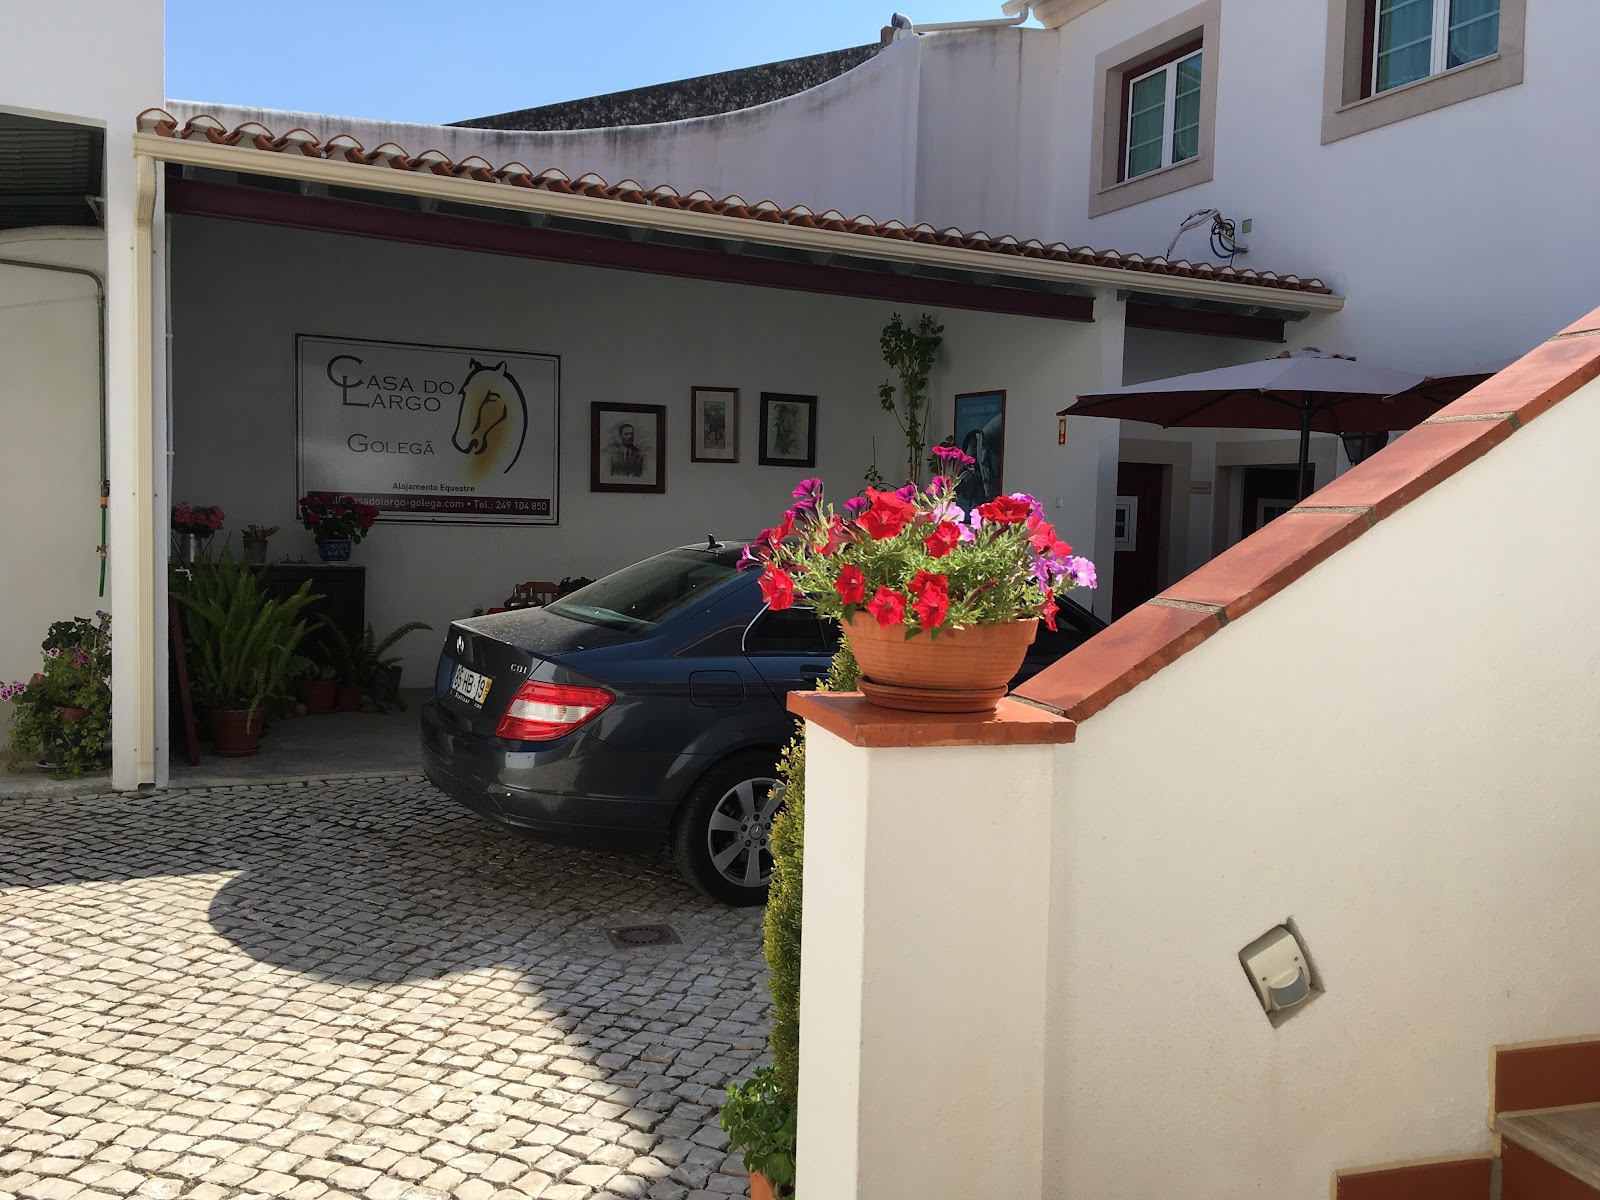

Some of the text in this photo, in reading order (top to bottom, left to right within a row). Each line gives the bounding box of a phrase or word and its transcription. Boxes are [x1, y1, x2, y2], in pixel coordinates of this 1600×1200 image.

[327, 355, 455, 396] CASA DO
[341, 375, 441, 412] LARGO
[347, 433, 435, 455] GOLEGÃ
[392, 482, 476, 493] Alojamento Equestre
[495, 500, 512, 510] 249
[514, 501, 530, 511] 104
[531, 501, 547, 511] 850
[510, 663, 529, 674] CDI
